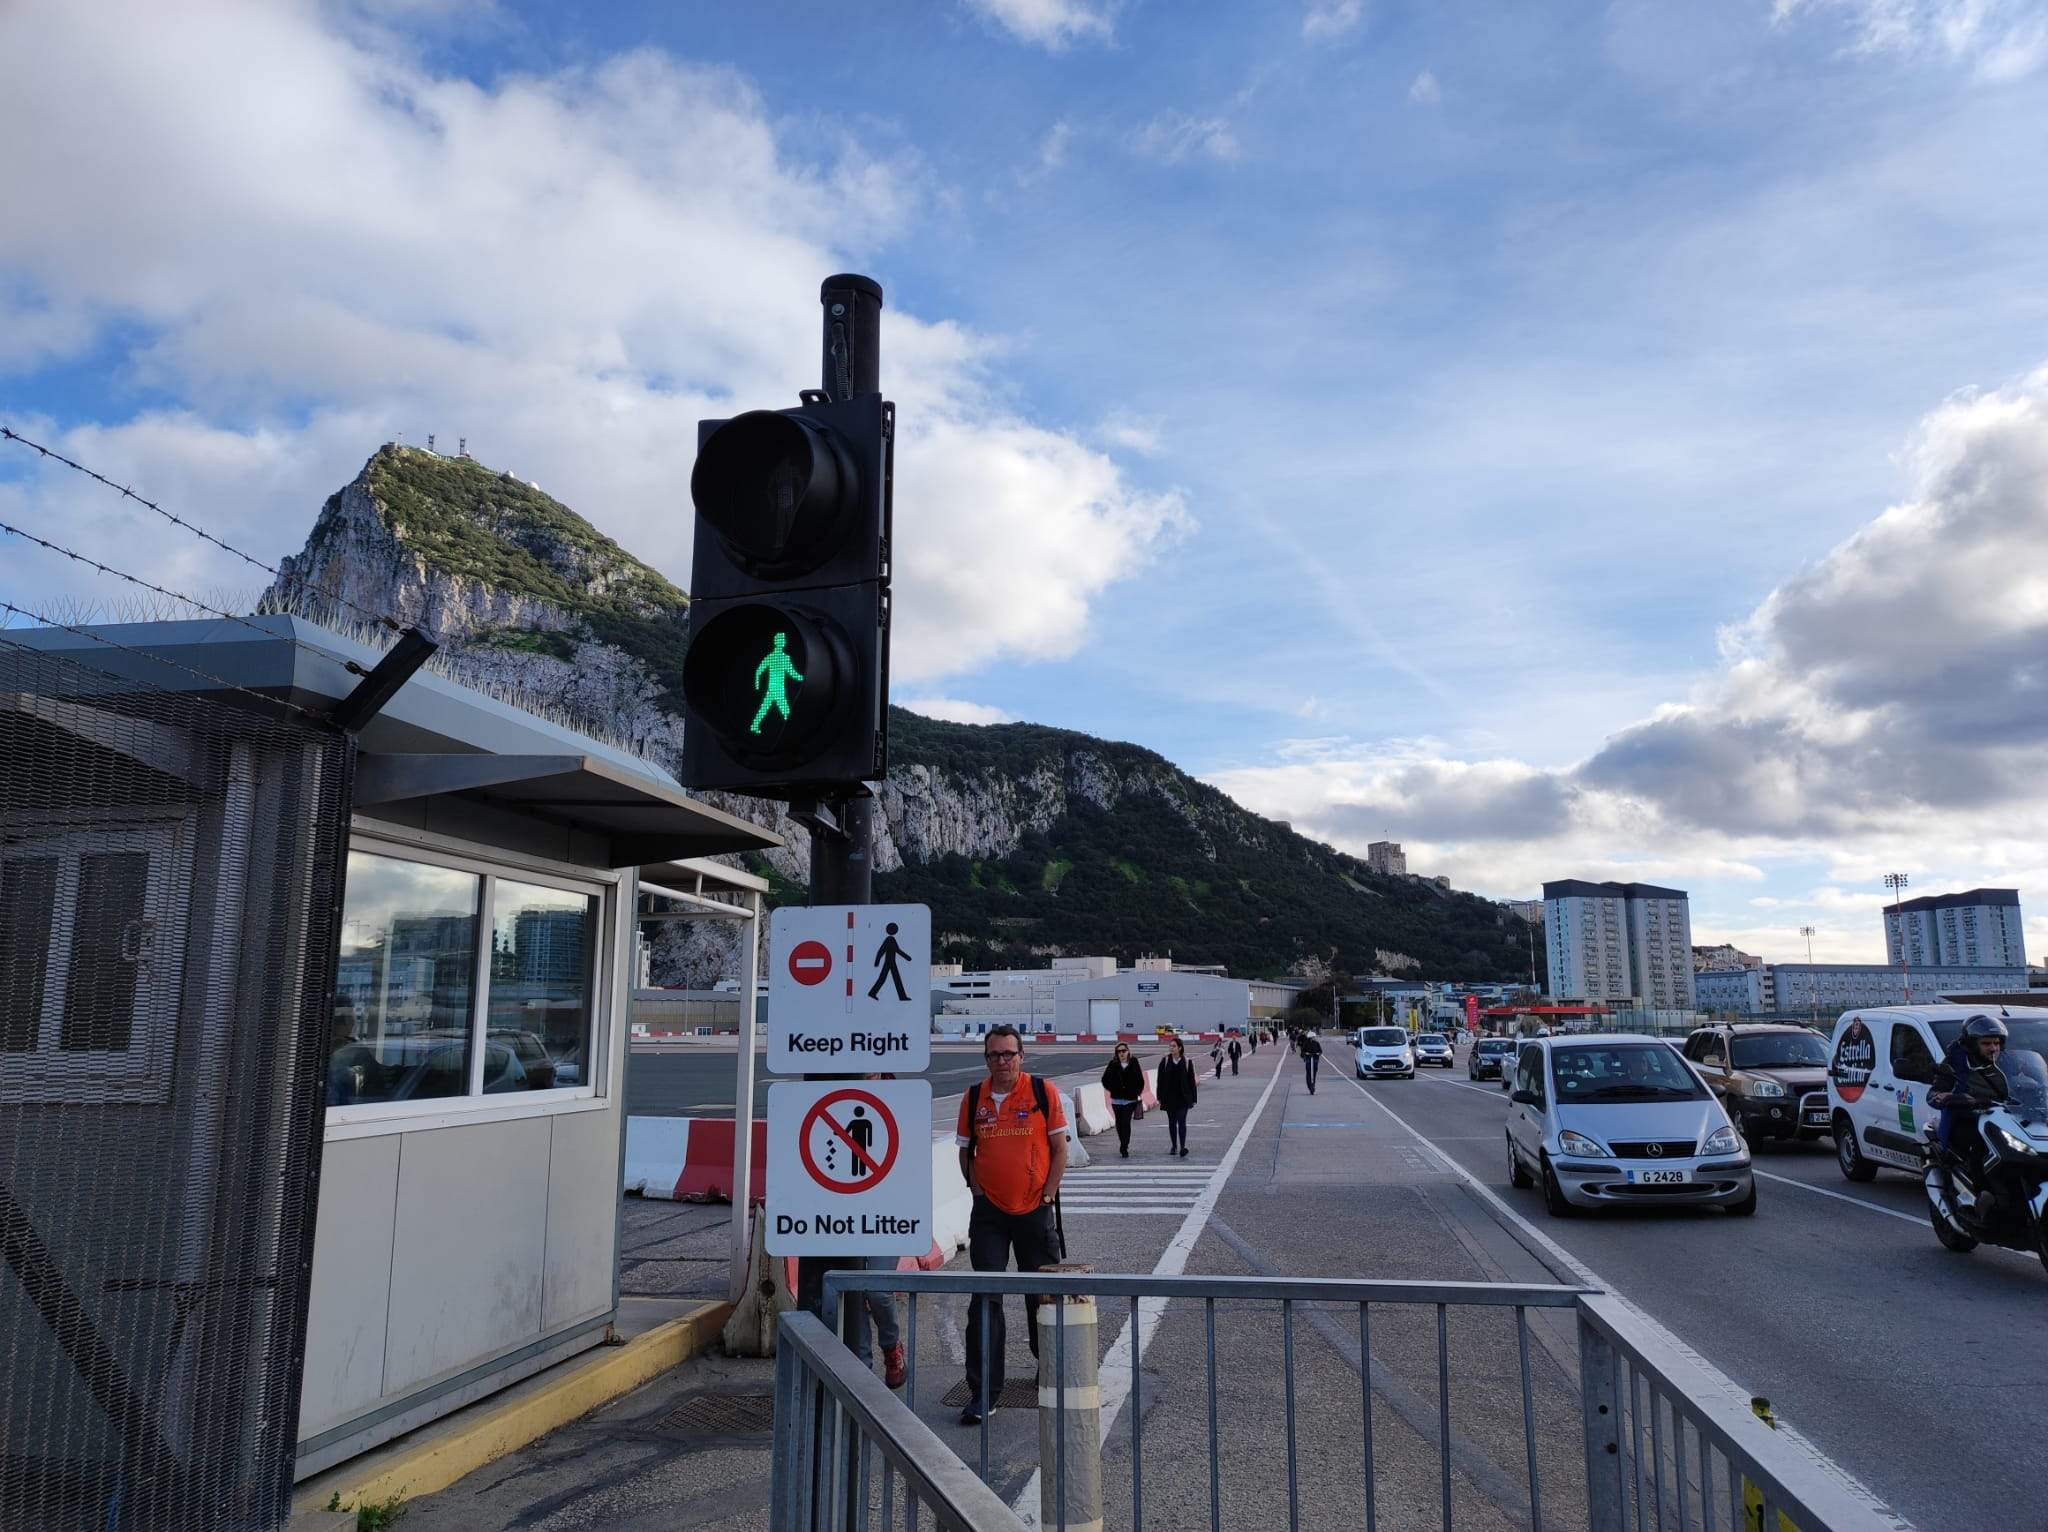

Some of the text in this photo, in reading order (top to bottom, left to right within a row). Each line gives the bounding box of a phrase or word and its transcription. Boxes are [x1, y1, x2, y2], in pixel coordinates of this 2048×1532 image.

[789, 1032, 909, 1056] Keep Right
[1839, 1039, 1871, 1062] Estrella
[1643, 1171, 1683, 1182] G 2428
[776, 1214, 920, 1235] Do Not Litter
